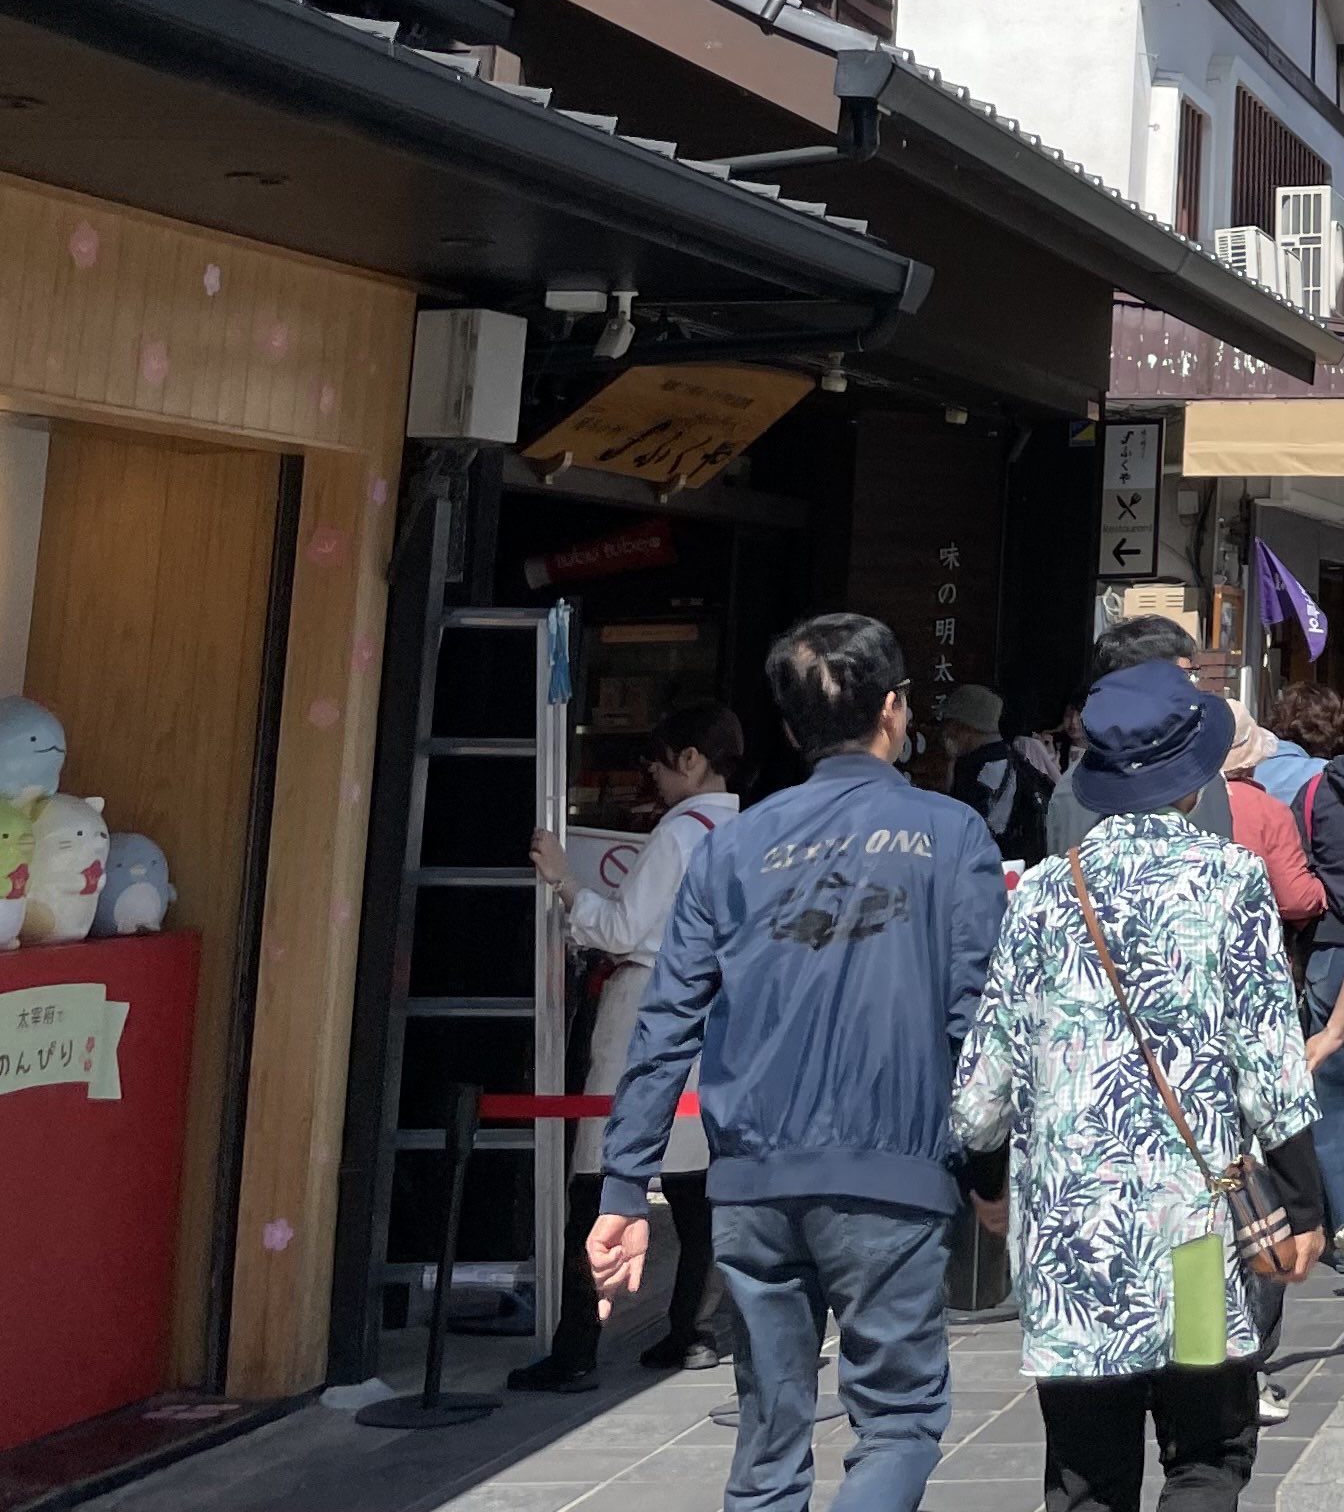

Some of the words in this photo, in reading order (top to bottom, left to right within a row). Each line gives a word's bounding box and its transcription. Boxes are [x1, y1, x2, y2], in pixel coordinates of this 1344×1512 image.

[931, 541, 961, 722] 味の明太子
[864, 828, 933, 858] ONE
